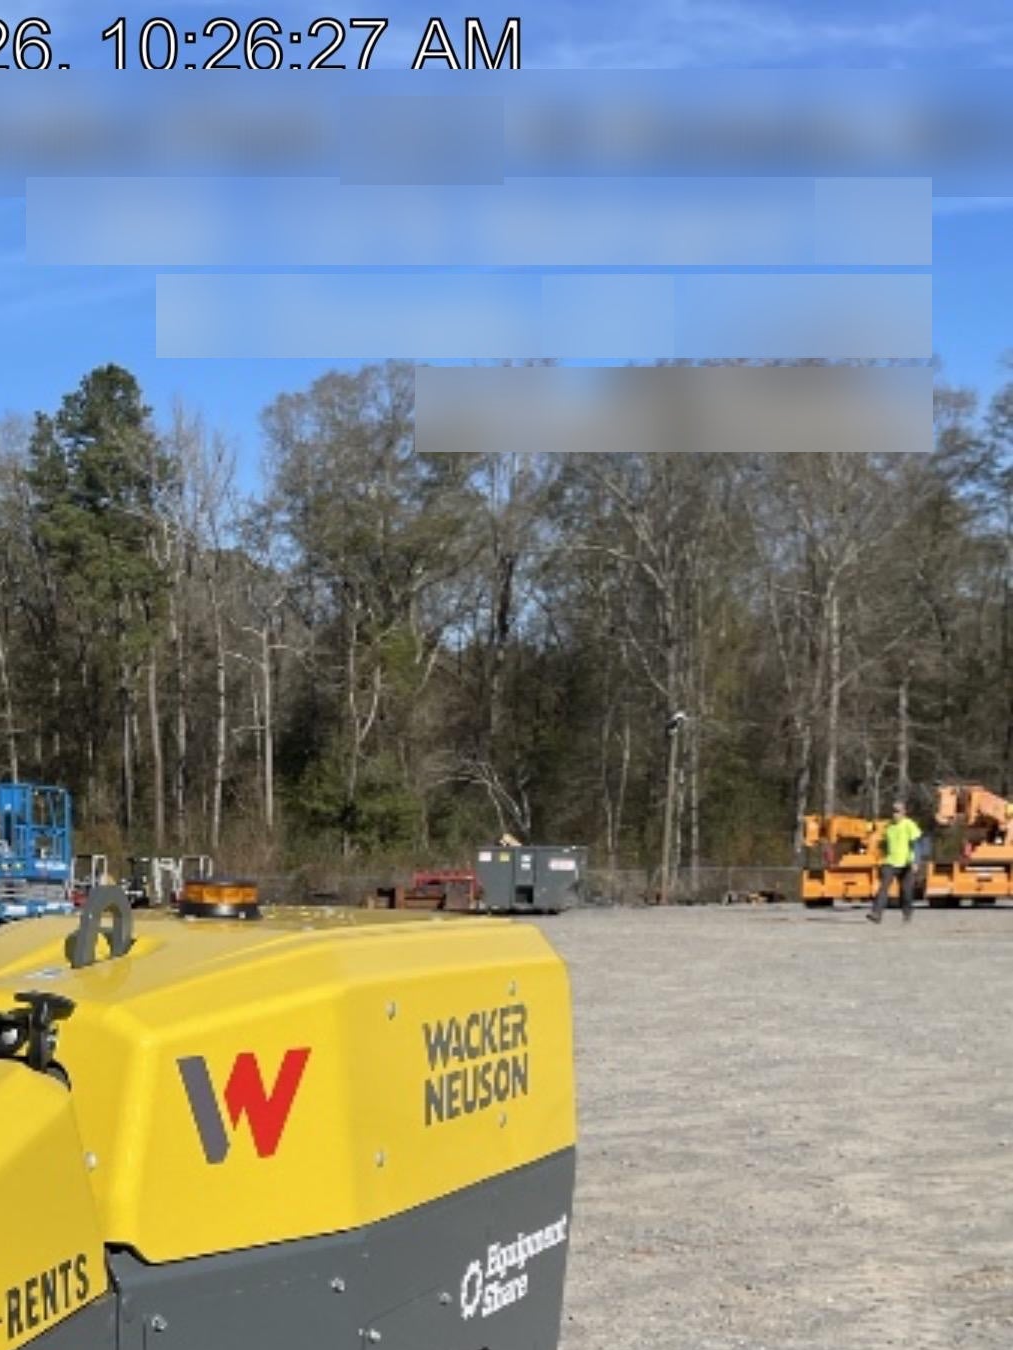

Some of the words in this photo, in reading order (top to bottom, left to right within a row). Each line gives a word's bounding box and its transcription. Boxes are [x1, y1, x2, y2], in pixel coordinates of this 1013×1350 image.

[422, 1004, 528, 1070] WACKER
[424, 1053, 528, 1126] NEUSON
[485, 1214, 567, 1278] Equipment
[482, 1274, 528, 1318] Share
